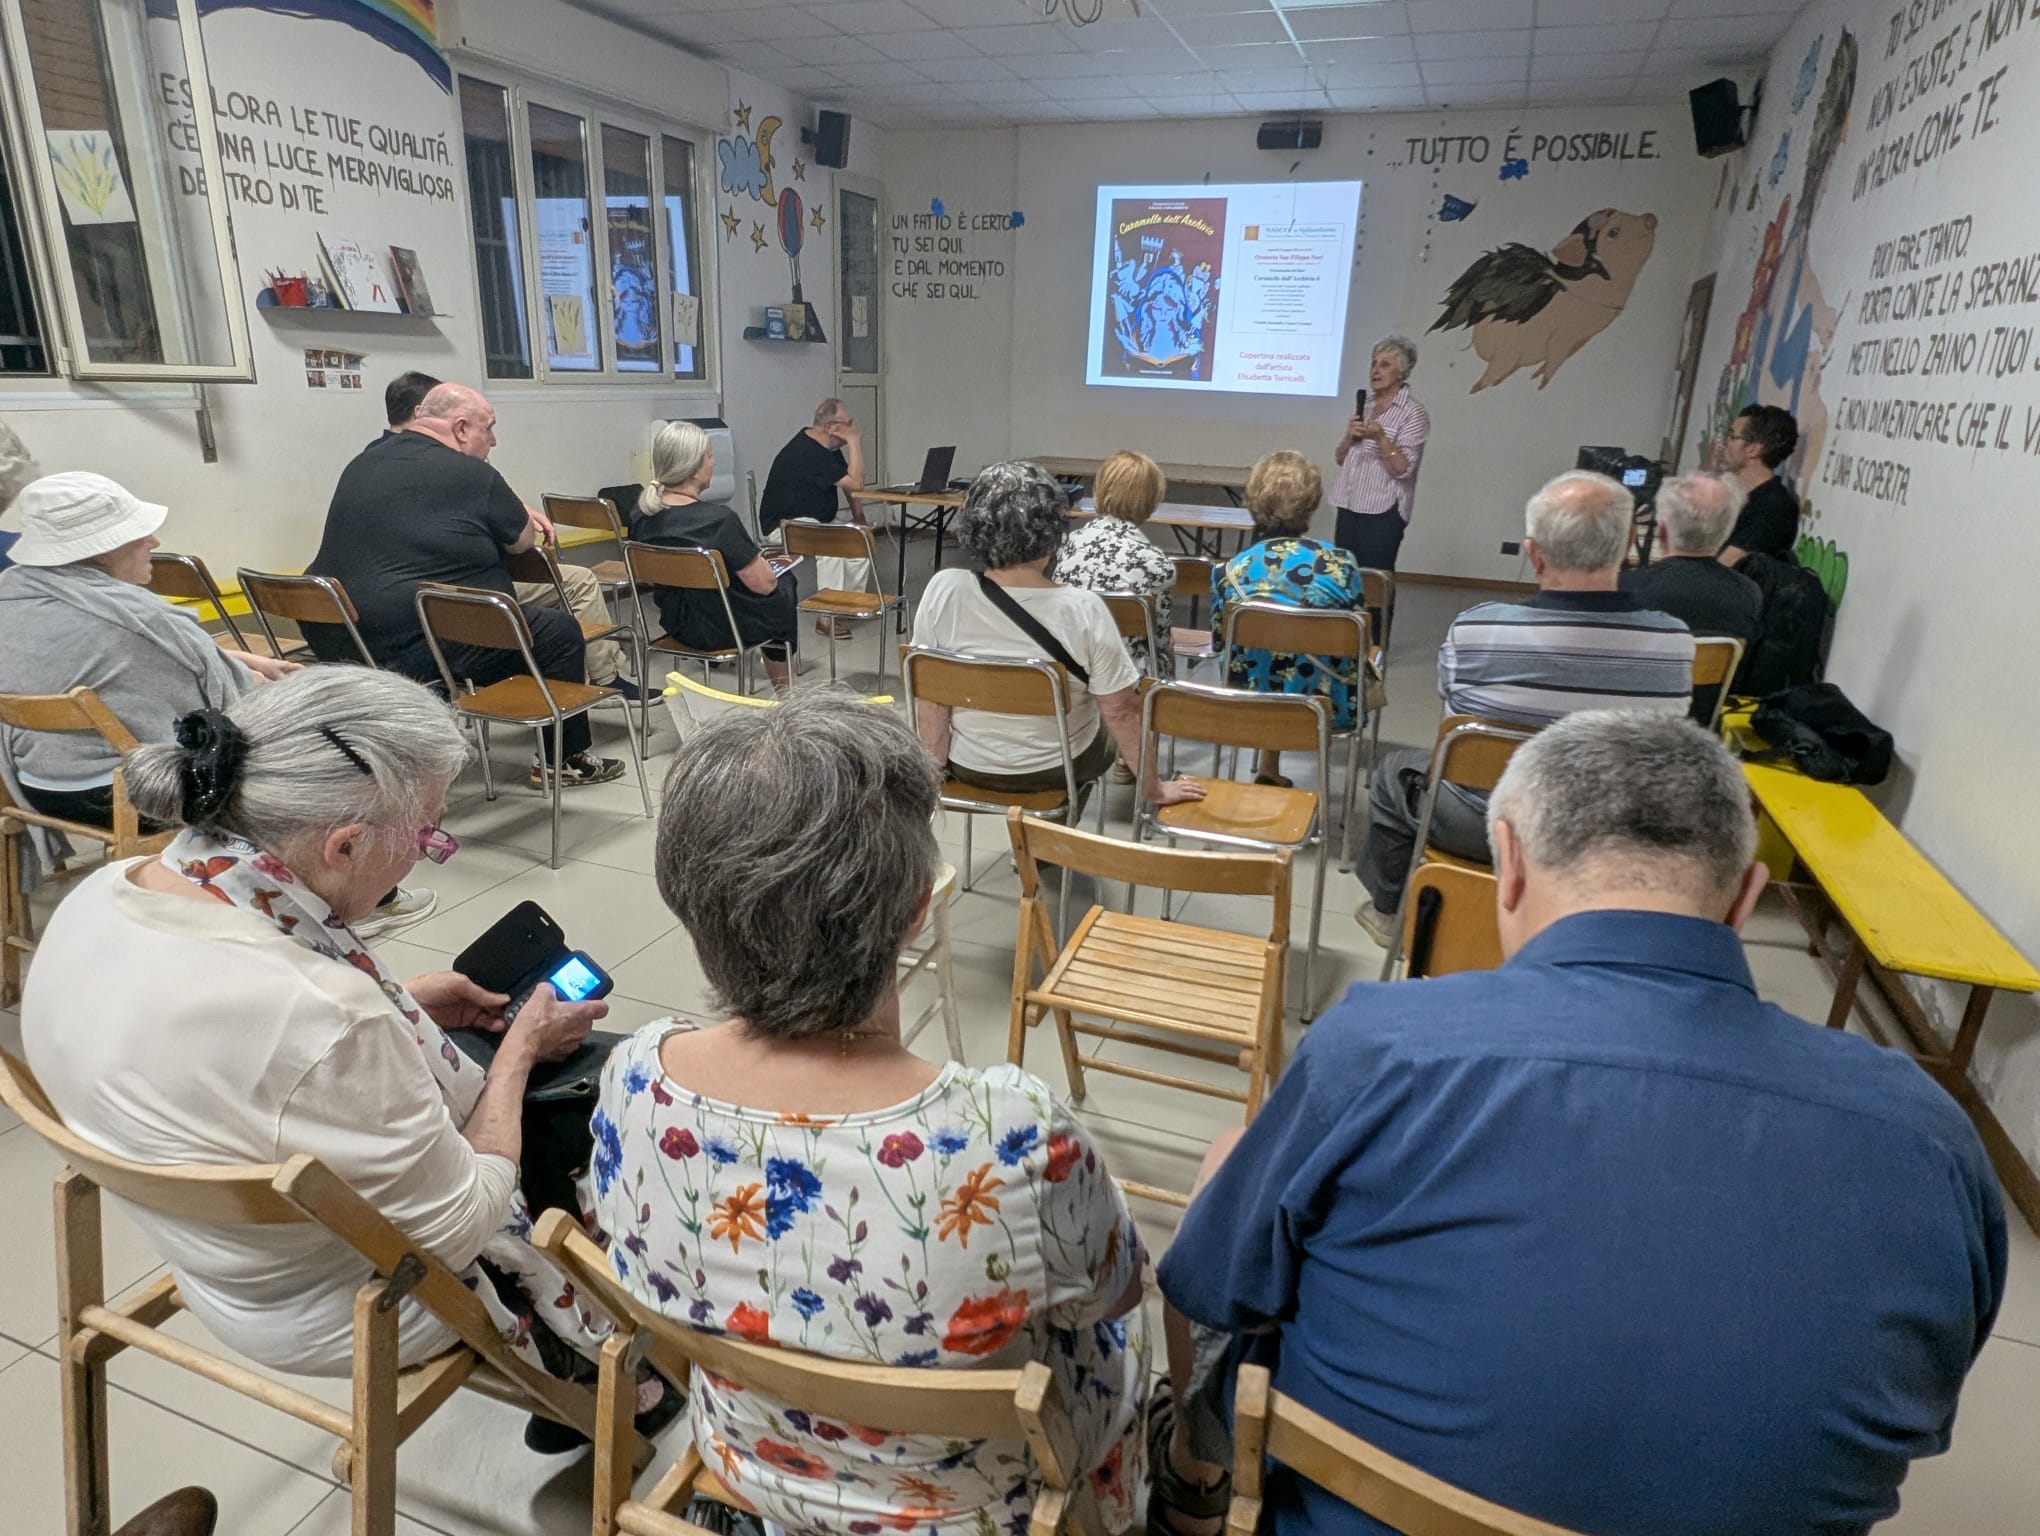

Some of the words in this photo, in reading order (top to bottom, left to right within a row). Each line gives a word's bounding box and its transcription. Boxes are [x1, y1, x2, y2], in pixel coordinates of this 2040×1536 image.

[160, 72, 283, 129] ESLORA
[290, 106, 320, 138] LE
[320, 111, 364, 151] TUE
[1913, 92, 1973, 168] COME
[1531, 131, 1661, 163] POSSIBILE.
[263, 140, 325, 177] LUCE
[326, 152, 455, 203] MERAVIGLIOSA
[178, 165, 275, 206] DETRO
[279, 182, 301, 211] DI
[892, 214, 909, 230] UN
[1119, 213, 1162, 235] Caramelle
[891, 236, 909, 254] TU
[914, 236, 934, 253] SEI
[894, 259, 904, 275] E
[907, 259, 933, 276] DAL
[938, 259, 1005, 277] MOMENTO
[891, 281, 919, 298] CHE
[926, 282, 945, 299] SEI
[1892, 280, 1923, 321] CON
[1918, 274, 1943, 321] TE
[1937, 271, 1964, 316] LA
[1239, 351, 1274, 360] Copertina
[1275, 352, 1311, 361] realizzata
[1880, 337, 1921, 377] NELLO
[1920, 331, 1977, 377] ZAINO
[1986, 326, 2034, 379] TUOI
[1237, 372, 1272, 382] Elisabetta
[1845, 398, 1871, 432] NON
[1867, 399, 1958, 444] DIMENTICARE
[1956, 400, 1997, 449] CHE
[1993, 403, 2013, 450] IL
